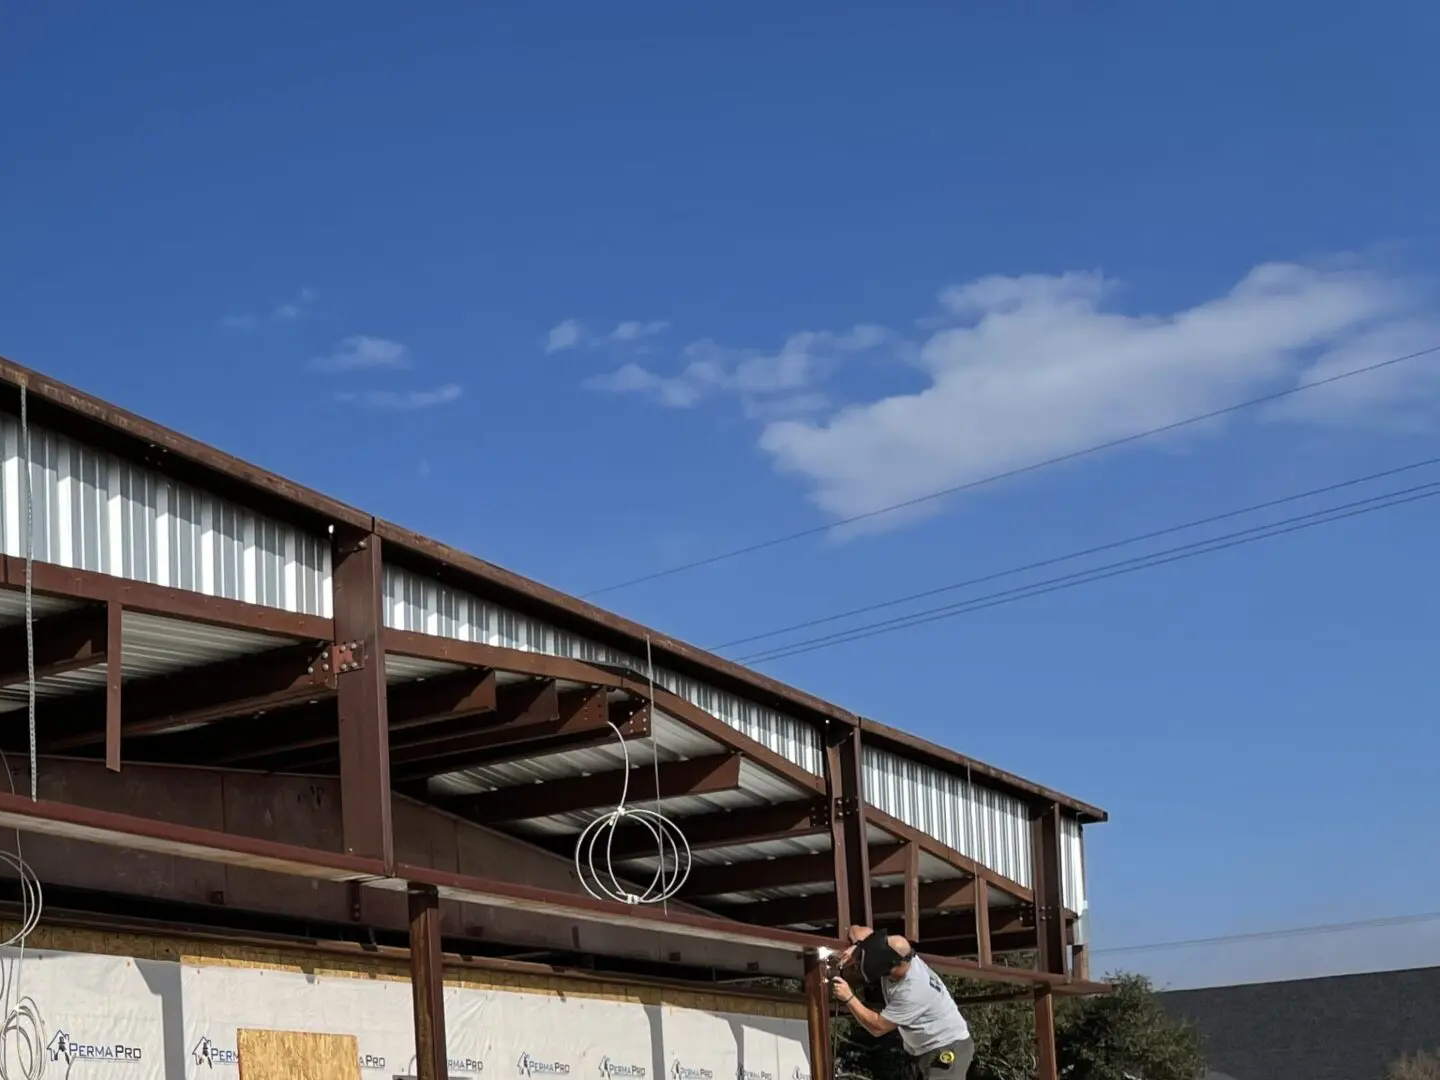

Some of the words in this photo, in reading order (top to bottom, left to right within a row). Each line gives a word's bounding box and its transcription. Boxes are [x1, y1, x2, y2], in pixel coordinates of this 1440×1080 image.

[69, 1043, 114, 1057] PERMA
[115, 1045, 141, 1059] PRO
[211, 1048, 238, 1061] PER
[365, 1054, 385, 1068] PRO
[448, 1060, 465, 1070] RMA
[465, 1059, 483, 1071] PRO
[529, 1061, 554, 1073] PERMA
[554, 1062, 570, 1074] PRO
[631, 1065, 646, 1077] PRO
